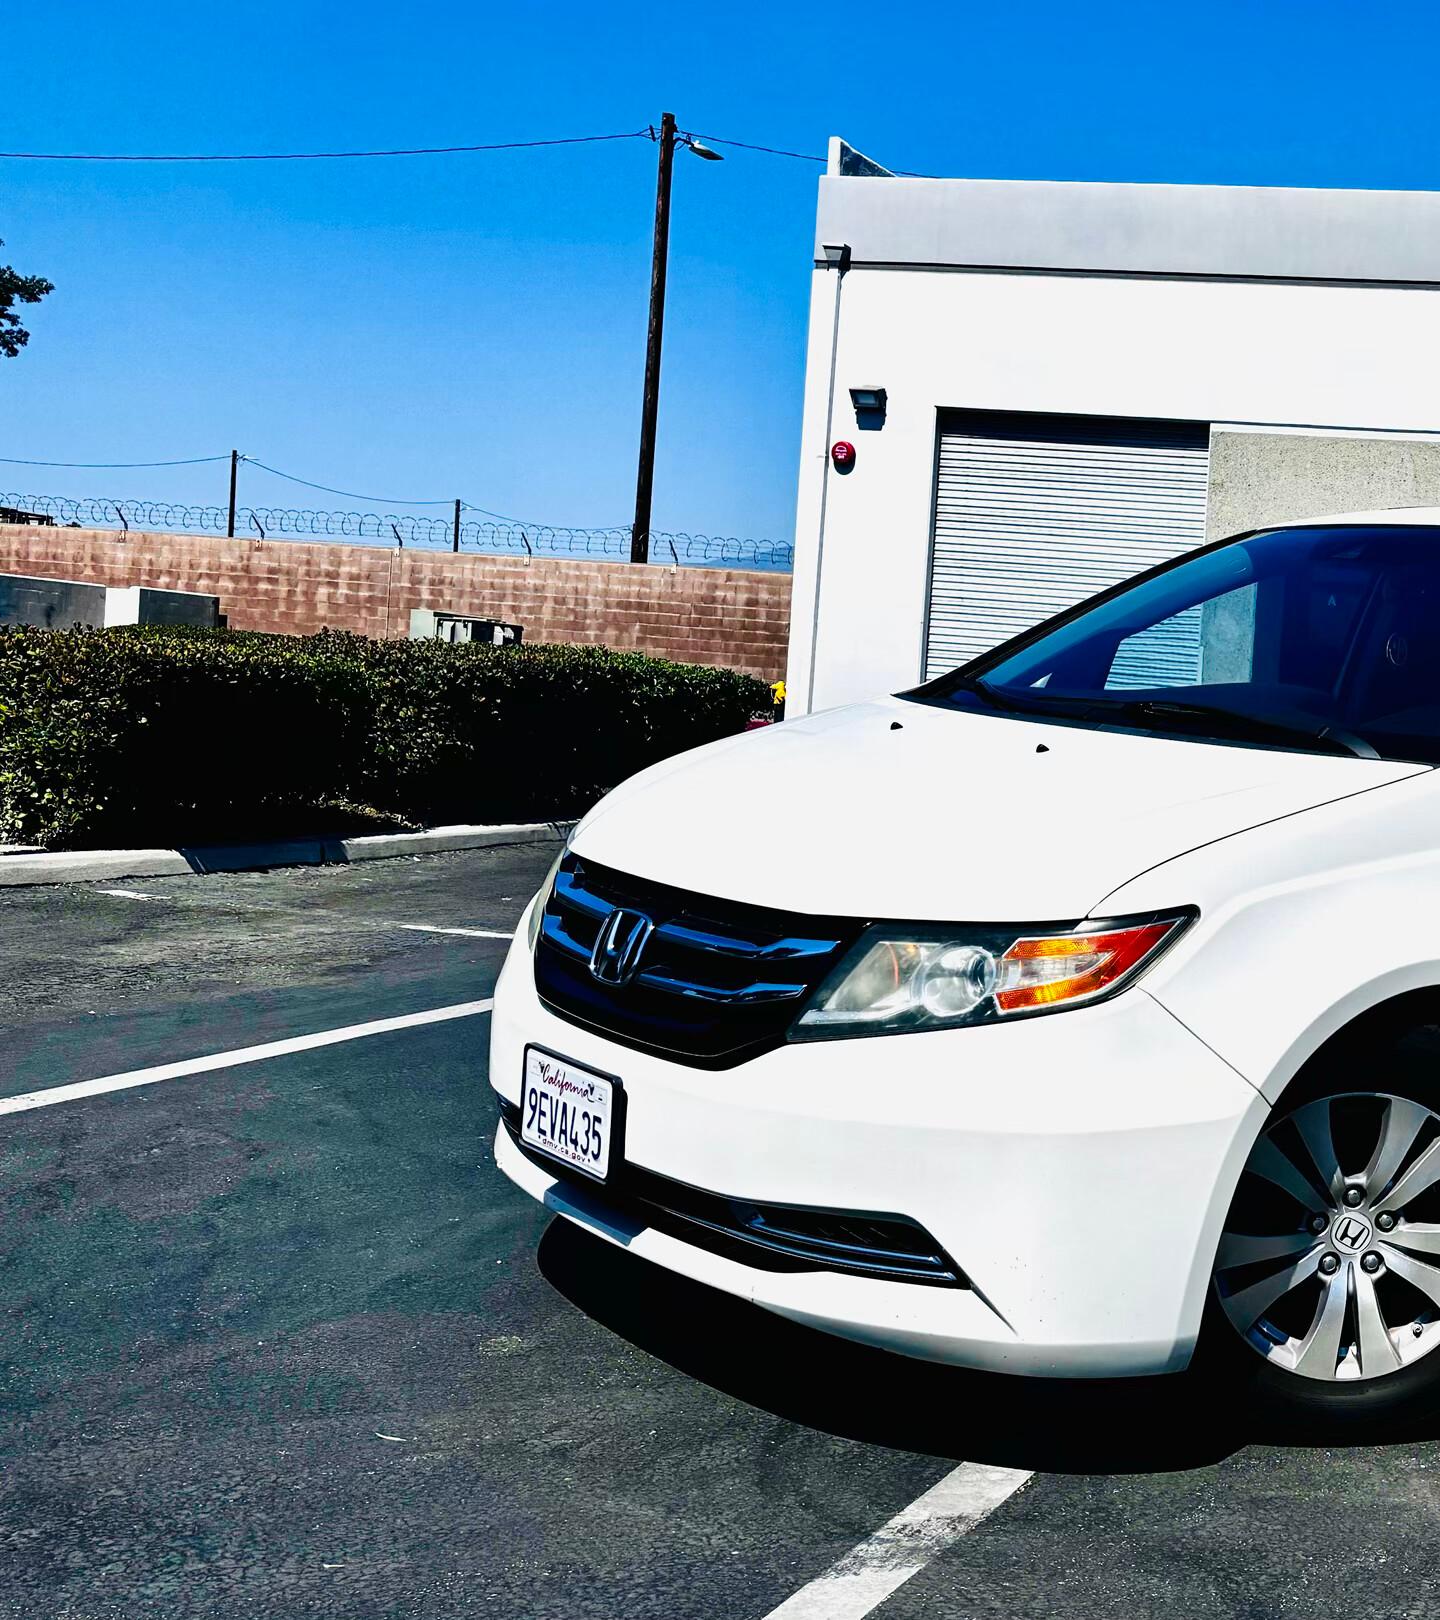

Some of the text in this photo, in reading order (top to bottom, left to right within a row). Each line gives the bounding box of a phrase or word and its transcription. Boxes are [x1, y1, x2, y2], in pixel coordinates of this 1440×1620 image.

[542, 1063, 594, 1103] California
[527, 1087, 602, 1161] 9EVA435
[542, 1137, 586, 1163] dmv.ca.gov
